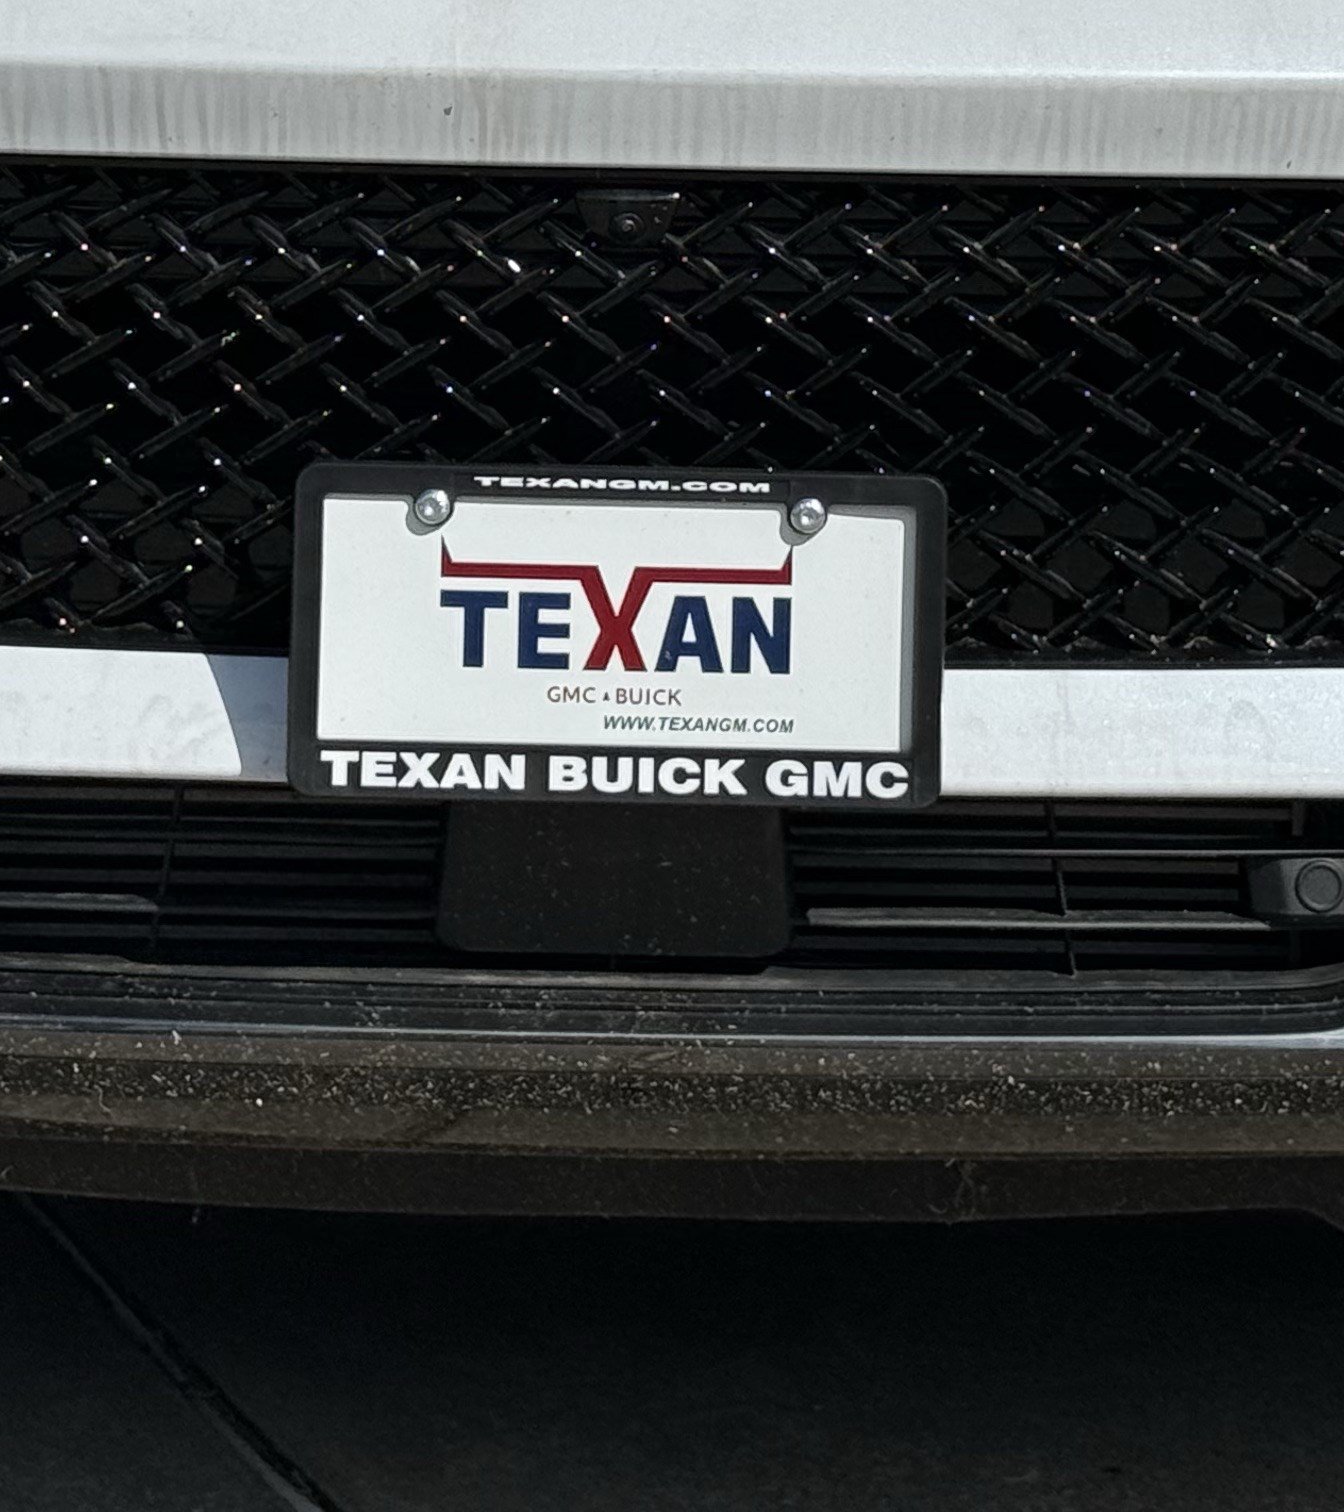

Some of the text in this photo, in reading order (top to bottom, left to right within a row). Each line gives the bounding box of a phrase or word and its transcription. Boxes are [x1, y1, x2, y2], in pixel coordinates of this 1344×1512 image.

[473, 475, 771, 493] TEXANGM.COM
[440, 564, 793, 674] TEXAN
[546, 686, 682, 707] GMC BUICK
[602, 714, 794, 734] WWW.TEXANGM.COM
[320, 750, 909, 799] TEXAN BUICK GMC
